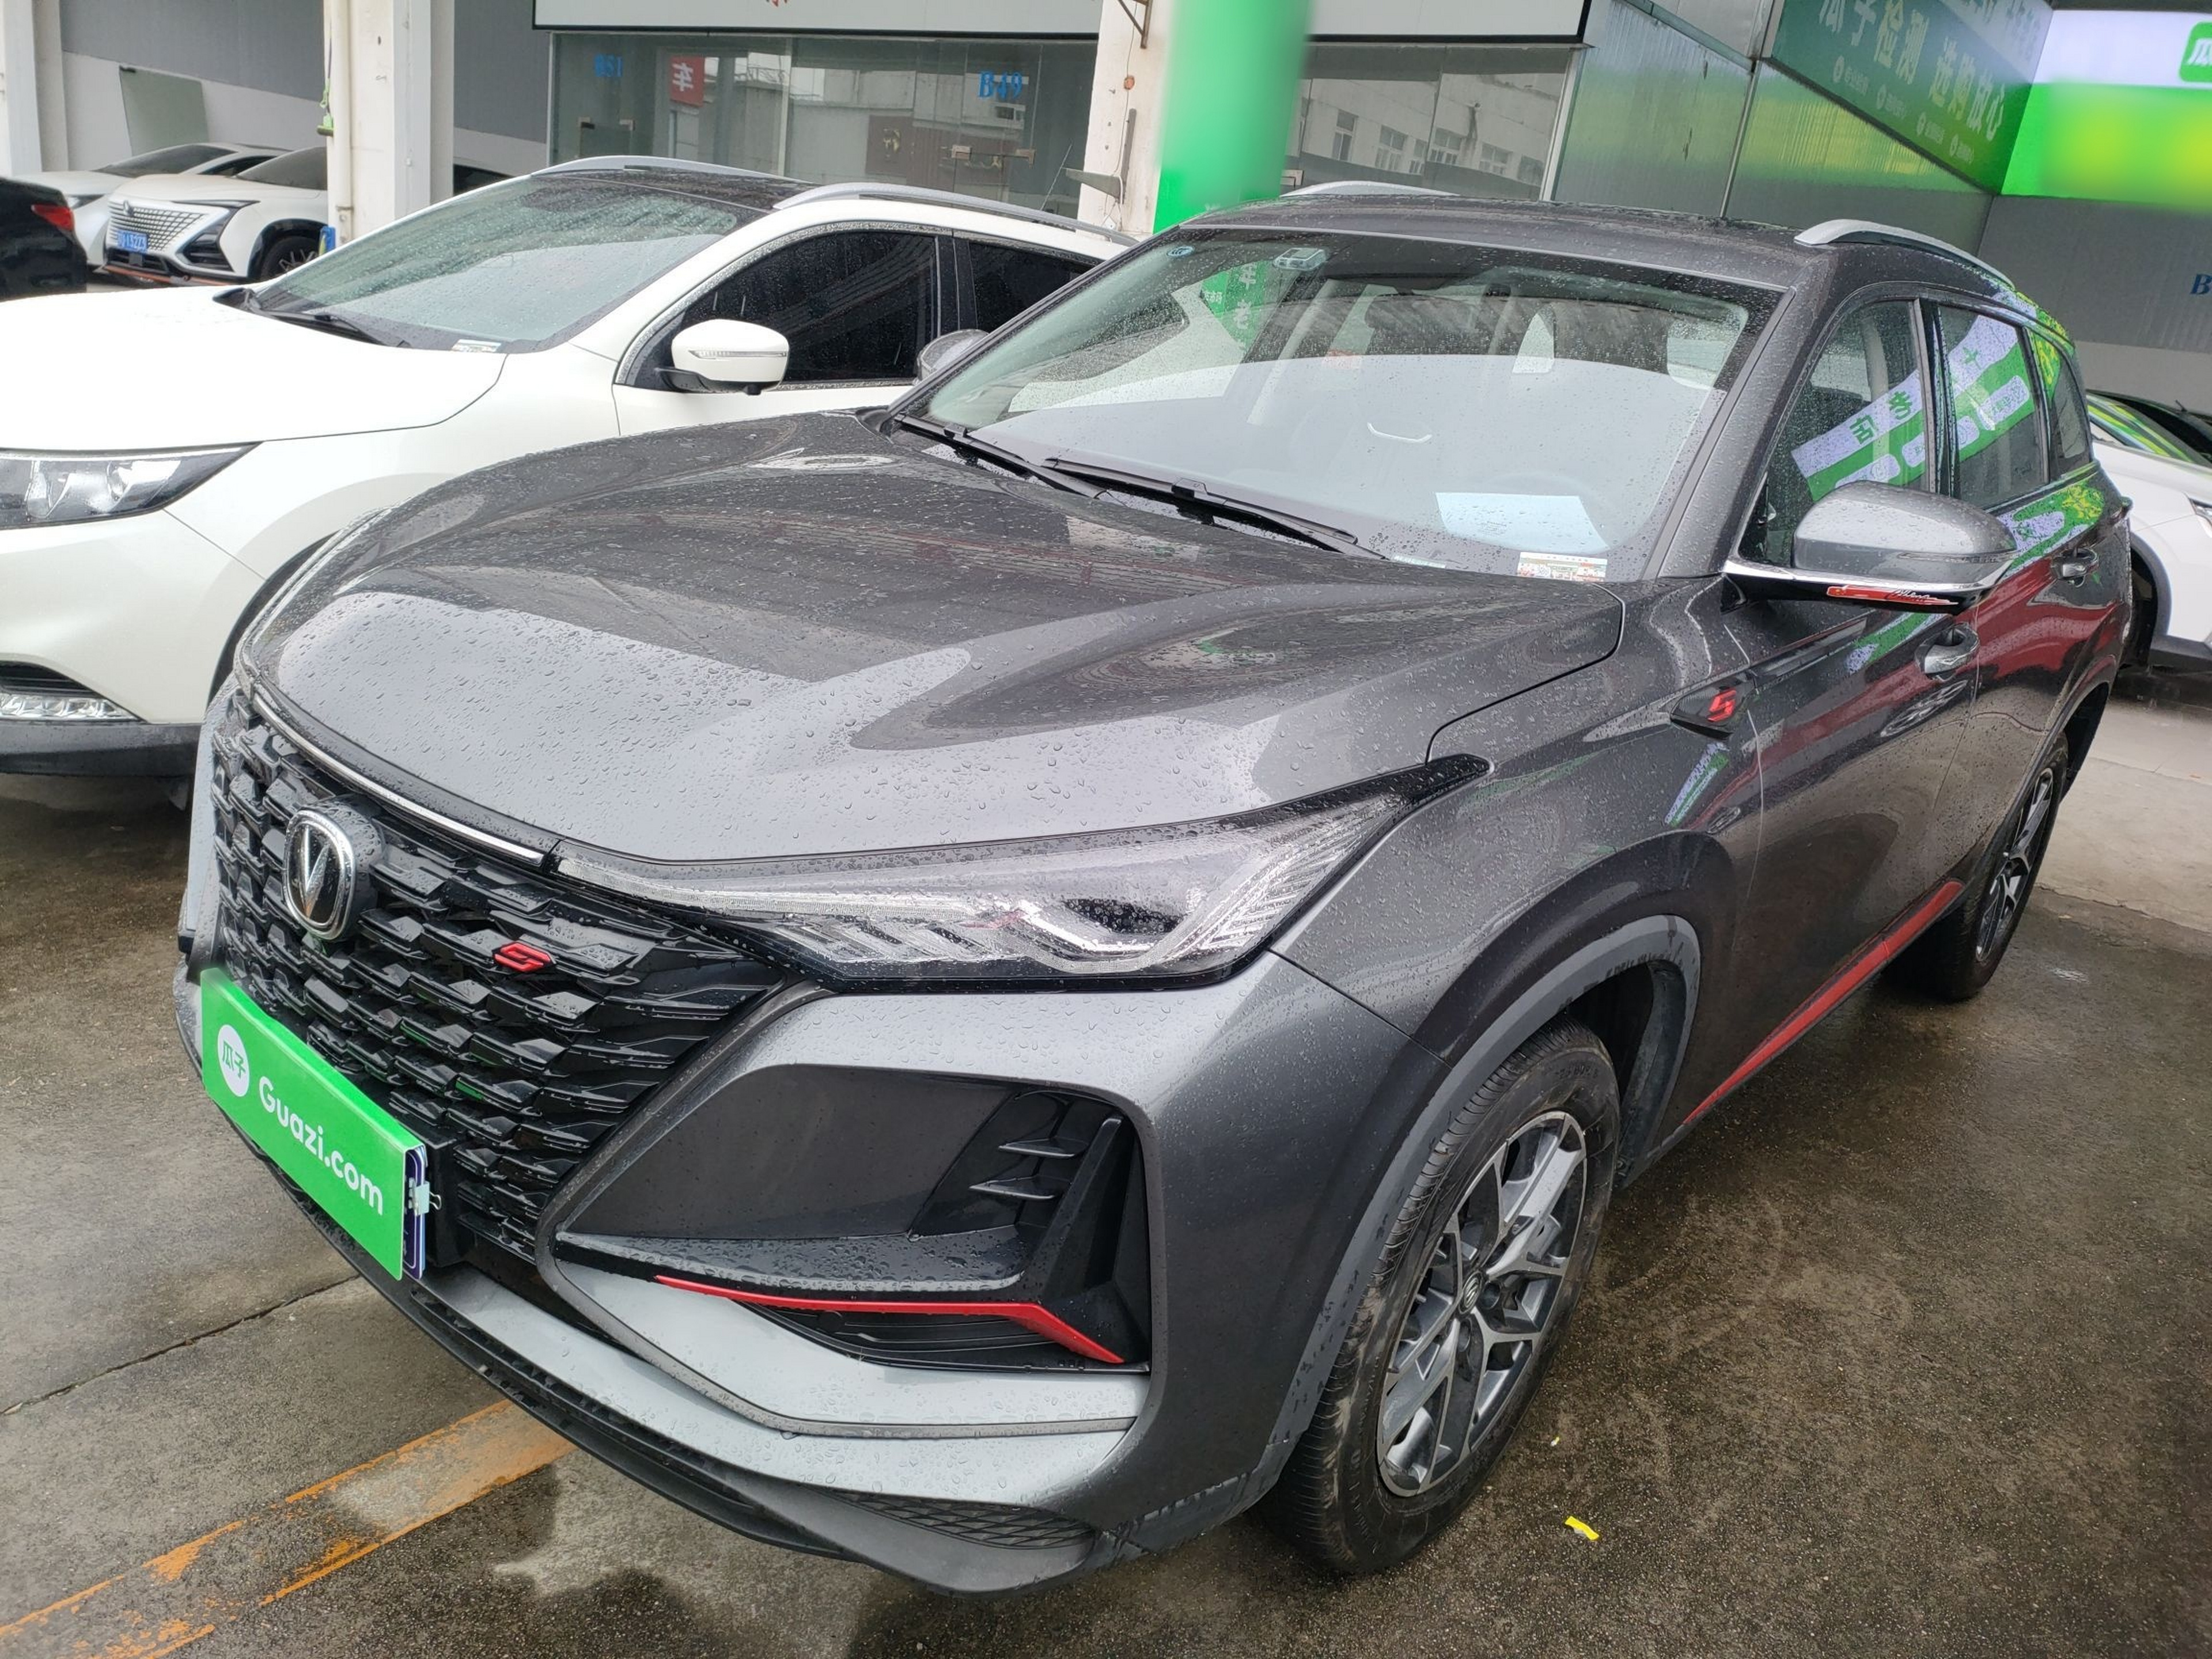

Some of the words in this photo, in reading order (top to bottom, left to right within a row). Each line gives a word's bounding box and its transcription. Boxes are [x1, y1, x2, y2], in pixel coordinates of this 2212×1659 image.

[979, 71, 1022, 100] B49
[222, 1040, 247, 1080] 瓜子
[259, 1075, 383, 1215] Guazi.com
